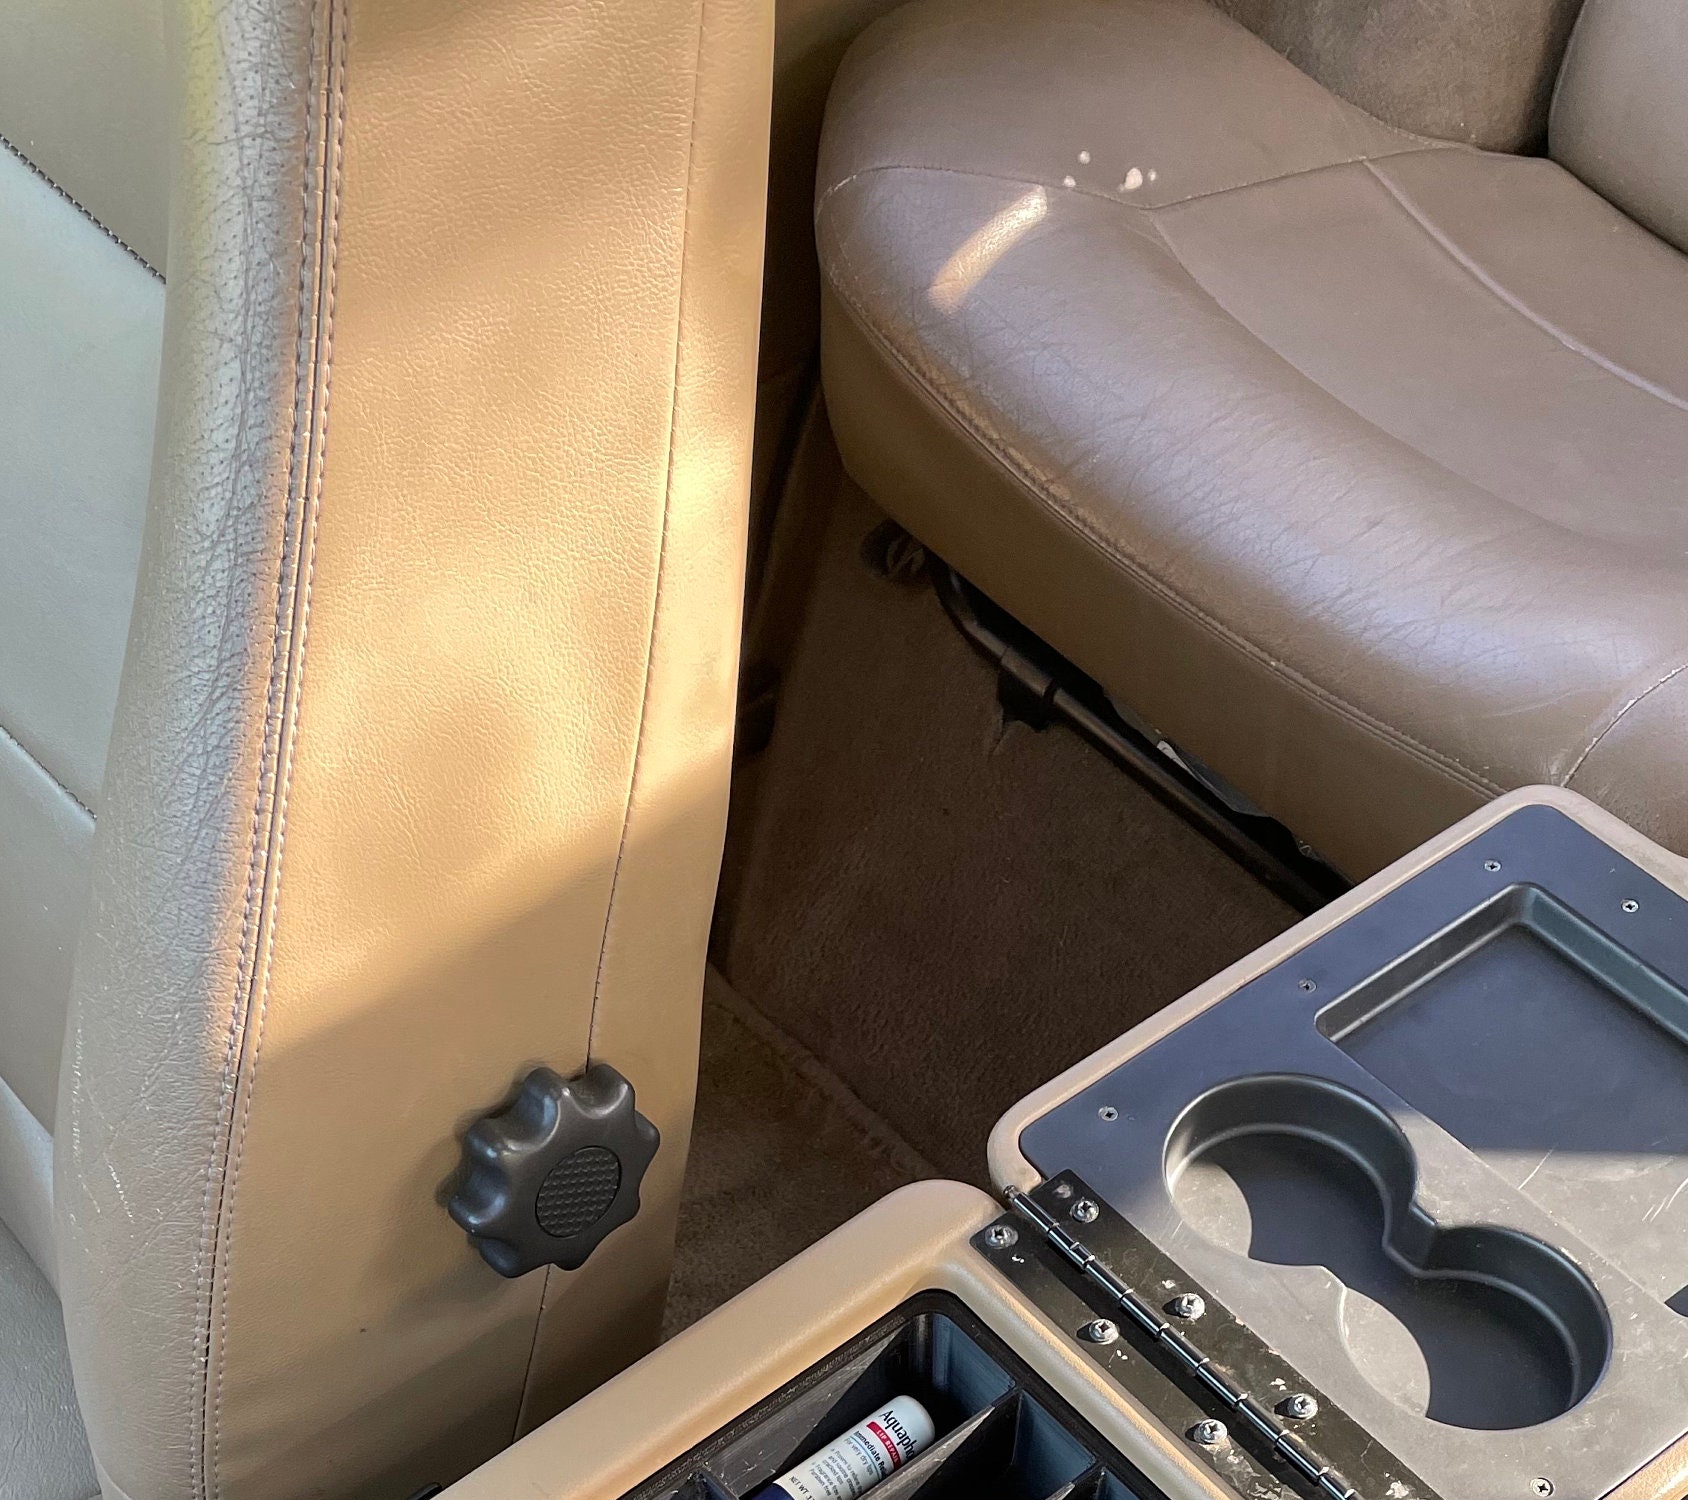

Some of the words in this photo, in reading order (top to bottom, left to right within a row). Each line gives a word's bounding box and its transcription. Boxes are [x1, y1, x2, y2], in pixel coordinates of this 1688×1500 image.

[854, 1431, 881, 1461] Immediate
[877, 1429, 887, 1441] LIP
[879, 1411, 916, 1458] Aquapho
[790, 1476, 801, 1485] NET
[799, 1485, 809, 1494] WT
